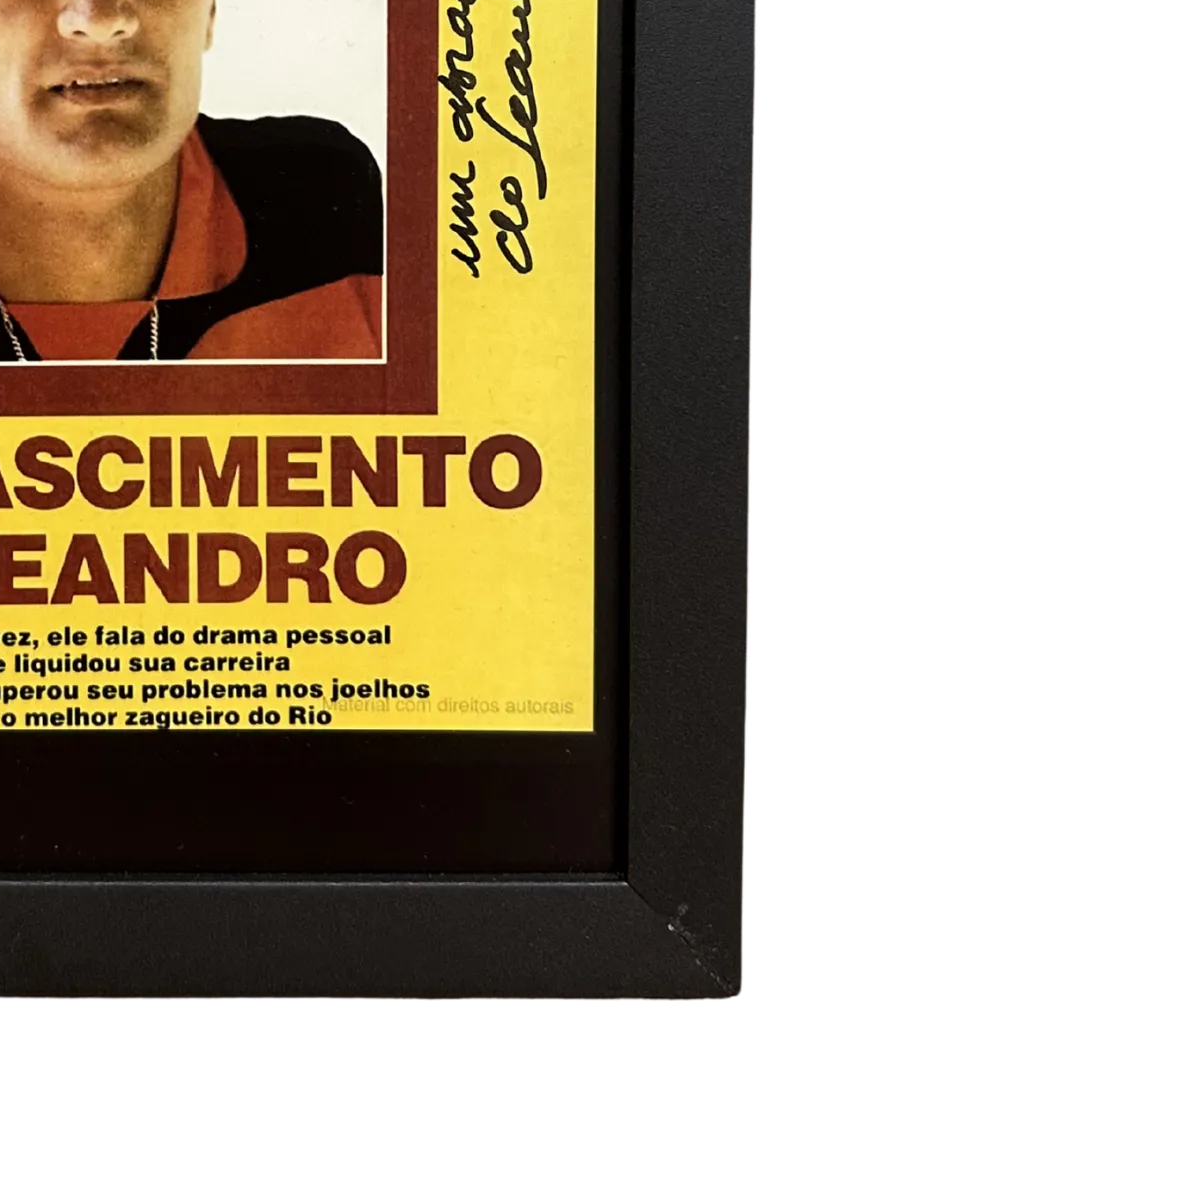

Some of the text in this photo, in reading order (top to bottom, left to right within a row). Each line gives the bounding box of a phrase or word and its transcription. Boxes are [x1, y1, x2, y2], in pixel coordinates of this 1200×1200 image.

[48, 627, 87, 646] ele
[95, 626, 144, 645] fala
[154, 626, 184, 645] do
[193, 626, 277, 644] drama
[287, 625, 390, 648] pessoal
[15, 653, 120, 677] liquidou
[130, 657, 175, 672] sua
[184, 652, 289, 671] carreira
[88, 685, 133, 699] seu
[142, 679, 266, 703] problema
[277, 684, 323, 698] nos
[331, 678, 429, 702] joelhos
[2, 713, 16, 726] o
[26, 707, 117, 726] melhor
[126, 706, 239, 728] zagueiro
[249, 706, 280, 725] do
[289, 706, 331, 725] Rio
